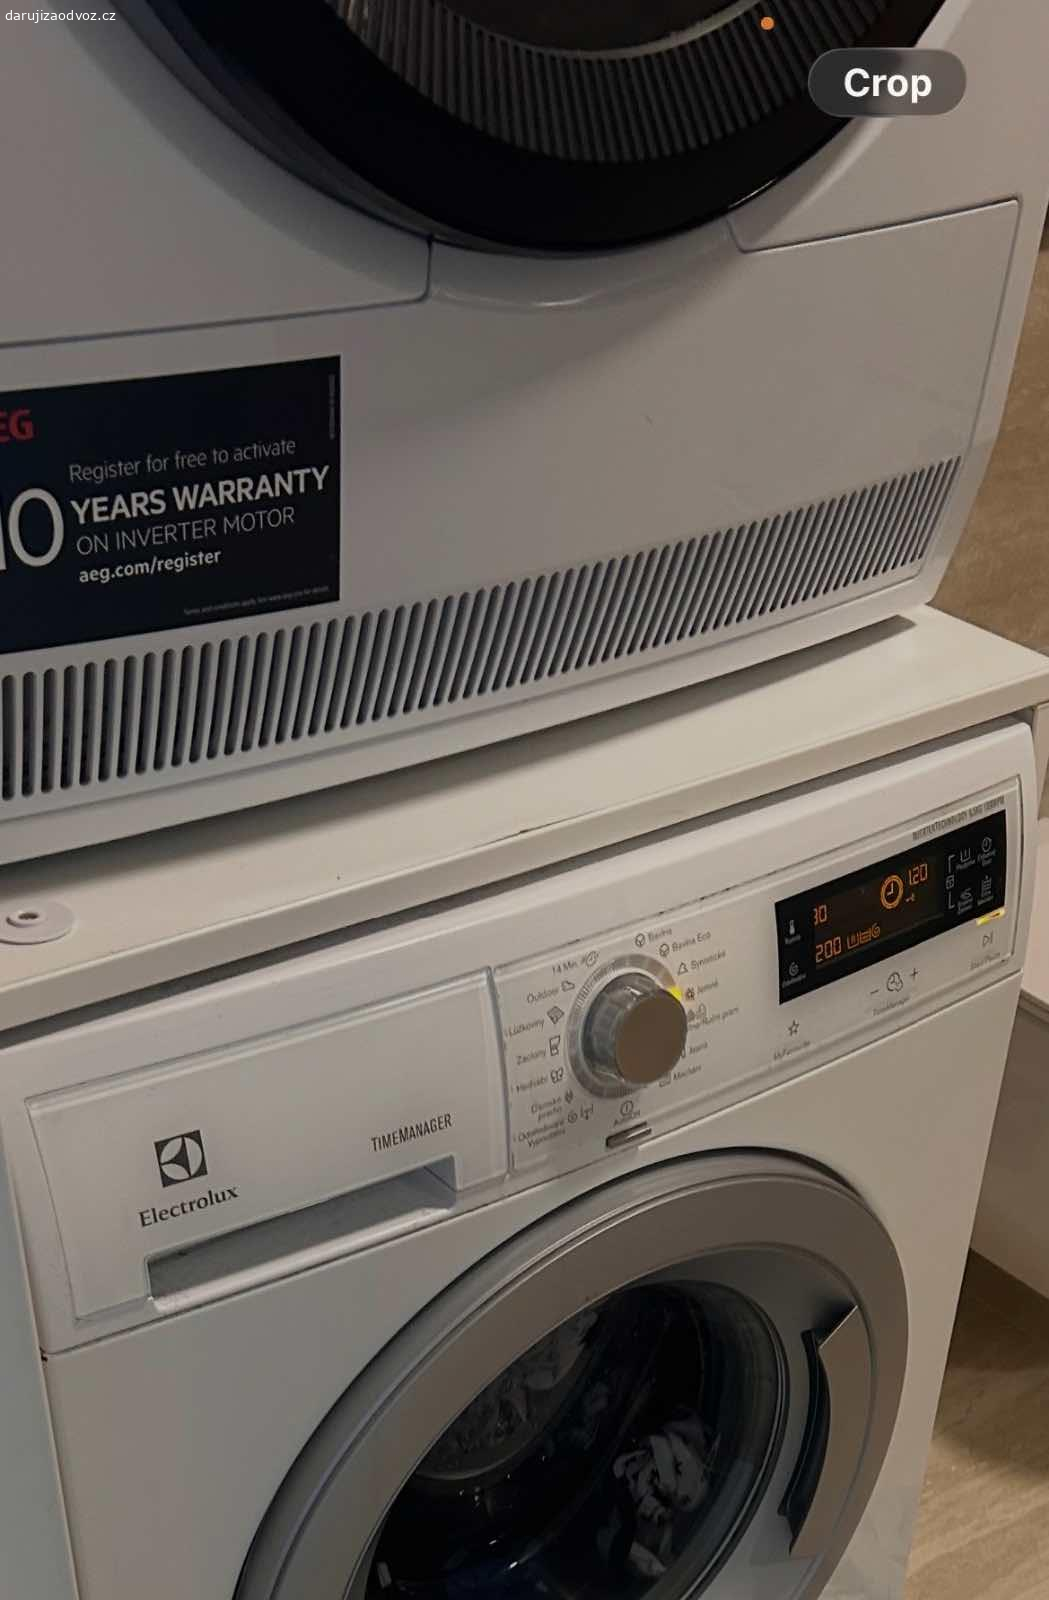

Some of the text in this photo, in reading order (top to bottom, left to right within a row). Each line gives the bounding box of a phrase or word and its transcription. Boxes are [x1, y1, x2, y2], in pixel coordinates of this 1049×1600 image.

[69, 438, 297, 485] Register for free to activate
[70, 464, 330, 526] YEARS WARRANTY
[76, 505, 295, 556] ON INVERTER MOTOR
[78, 550, 223, 584] aeg.com/register
[908, 863, 929, 887] 120
[371, 1113, 453, 1152] TIMEMANAGER
[138, 1185, 240, 1228] Electrolux
